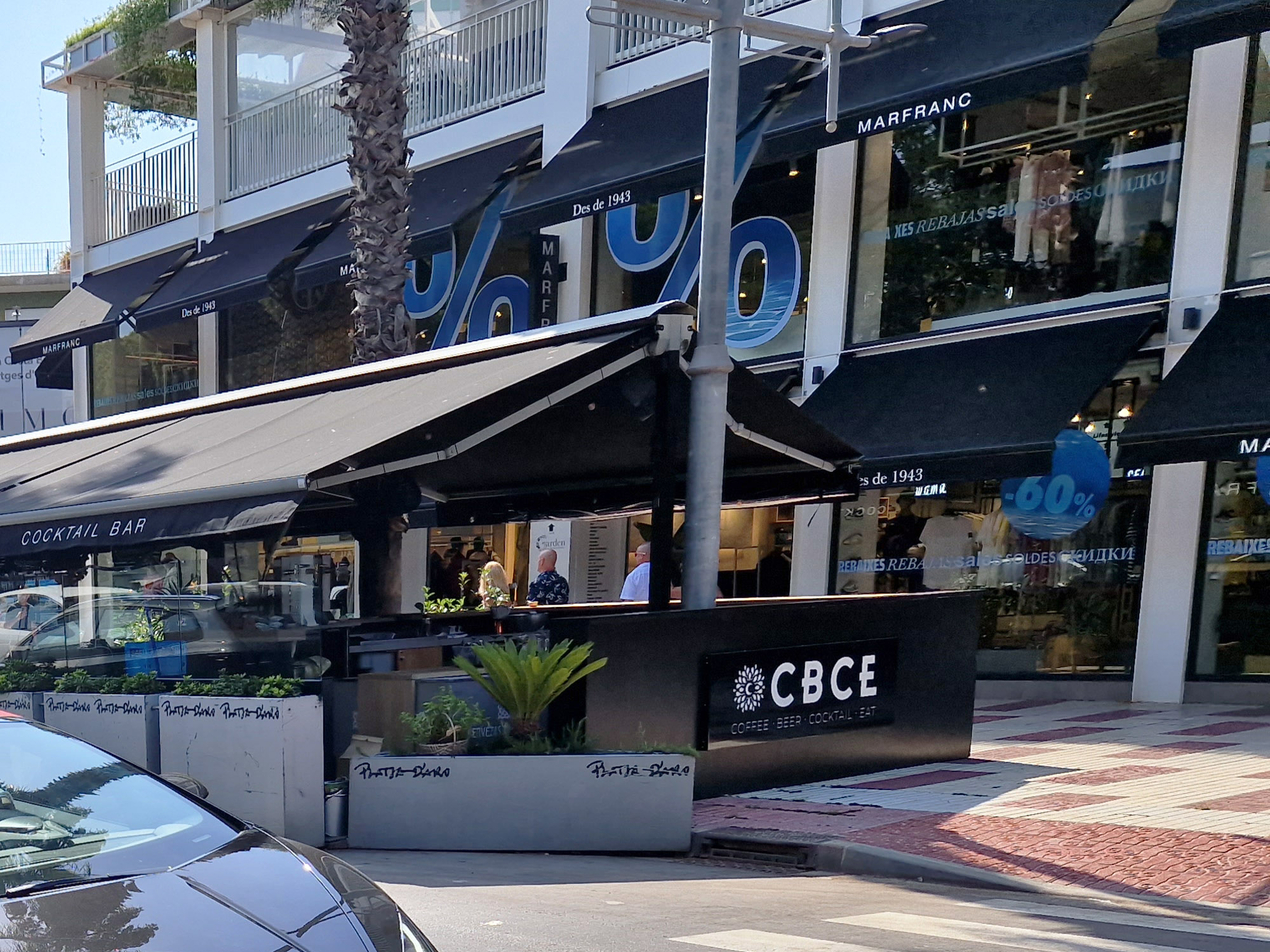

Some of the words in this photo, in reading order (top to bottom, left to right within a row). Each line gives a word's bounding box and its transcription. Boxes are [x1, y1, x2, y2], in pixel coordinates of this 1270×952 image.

[857, 92, 972, 134] MARFRANC
[573, 204, 591, 217] Des
[592, 199, 605, 212] de
[607, 190, 631, 208] 1943
[916, 208, 986, 234] REBAJAS
[181, 308, 192, 318] Des
[193, 305, 200, 314] de
[201, 300, 216, 313] 1943
[42, 337, 81, 354] MARFRANC
[872, 472, 887, 486] de
[892, 468, 923, 483] 1943
[21, 523, 99, 546] COCKTAIL
[109, 518, 147, 537] BAR
[1006, 551, 1056, 566] SOLDES
[770, 654, 878, 708] CBCE
[731, 719, 769, 735] COFFEE
[777, 715, 801, 729] BEER
[808, 709, 852, 725] COCKTAIL
[859, 705, 877, 719] EAT
